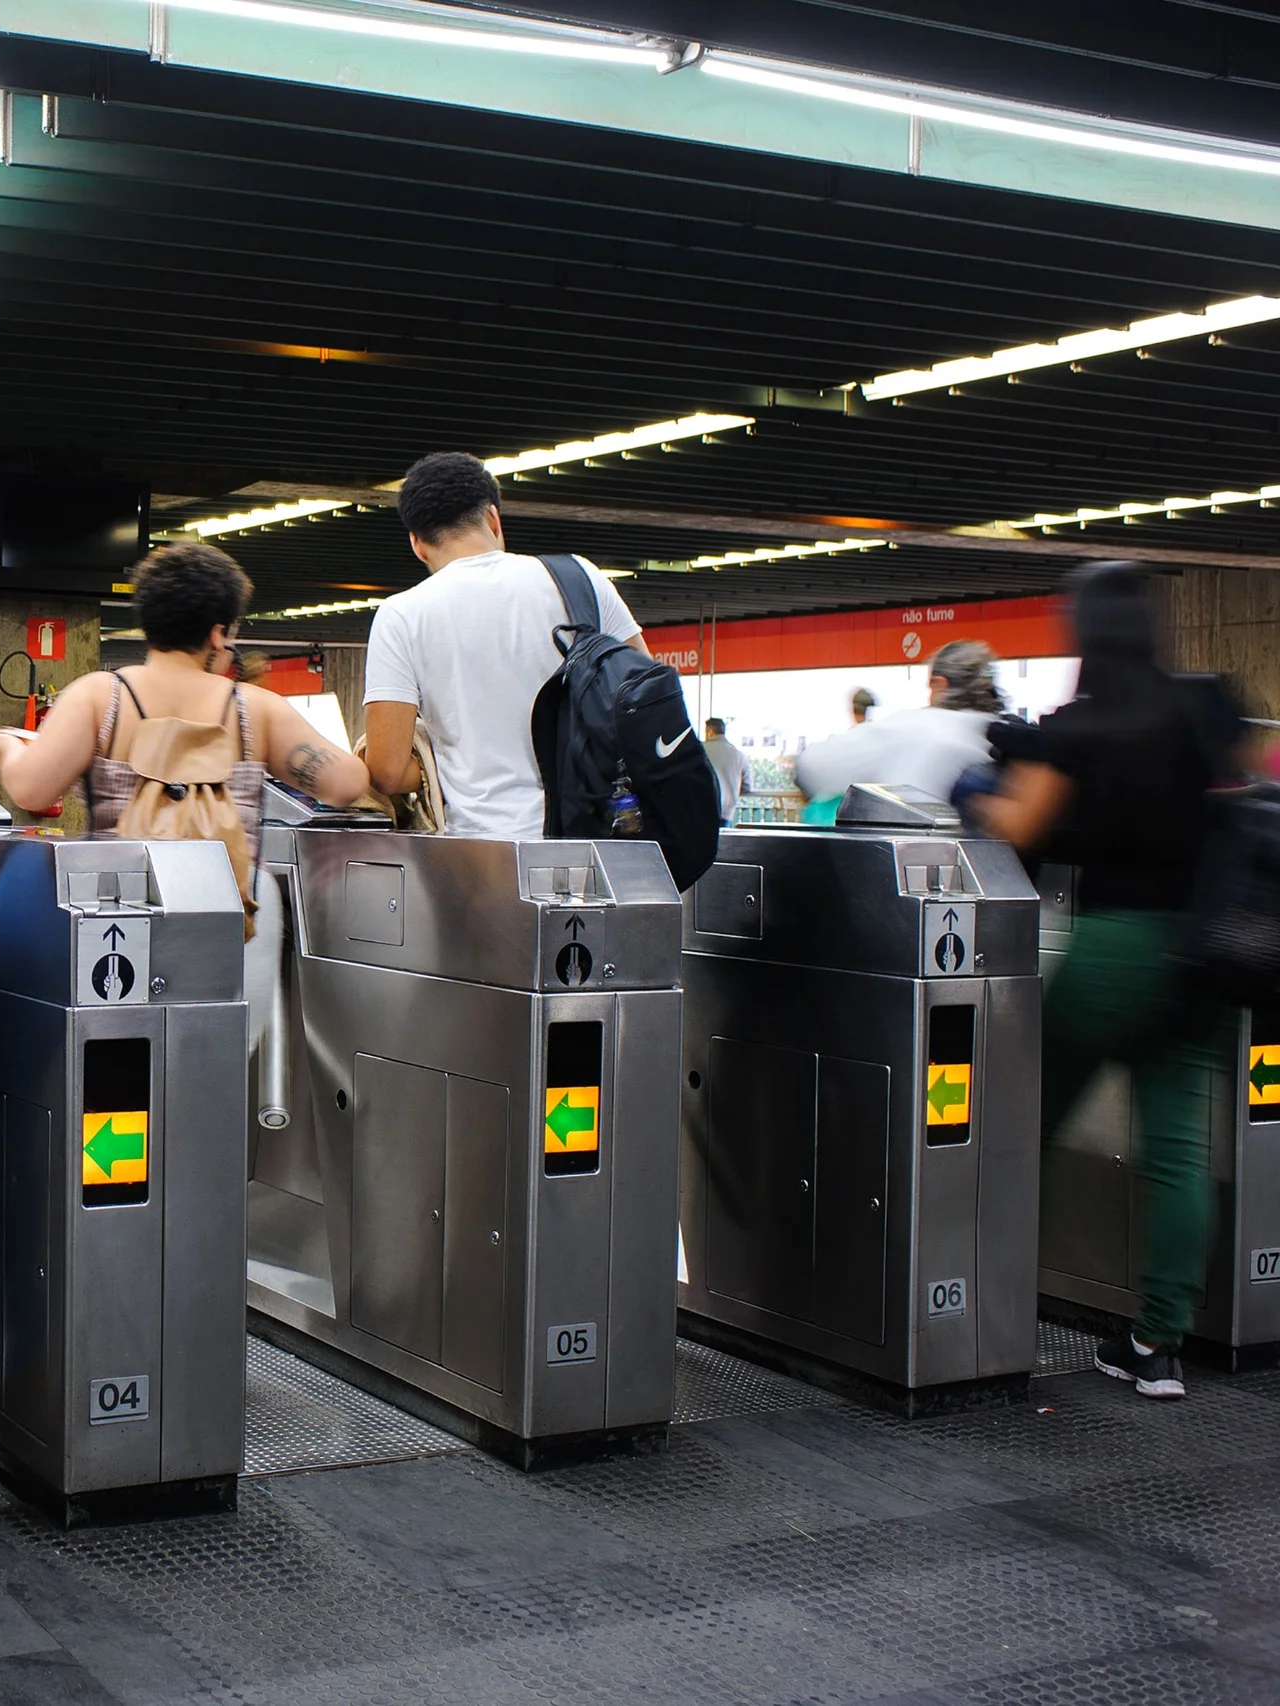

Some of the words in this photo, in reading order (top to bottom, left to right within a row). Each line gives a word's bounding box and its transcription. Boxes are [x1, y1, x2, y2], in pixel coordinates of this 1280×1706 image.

[902, 609, 923, 623] não
[926, 607, 955, 622] fume
[649, 650, 699, 671] arque
[1257, 1252, 1280, 1275] 07
[933, 1282, 962, 1309] 06
[557, 1329, 588, 1356] 05
[98, 1381, 141, 1412] 04
